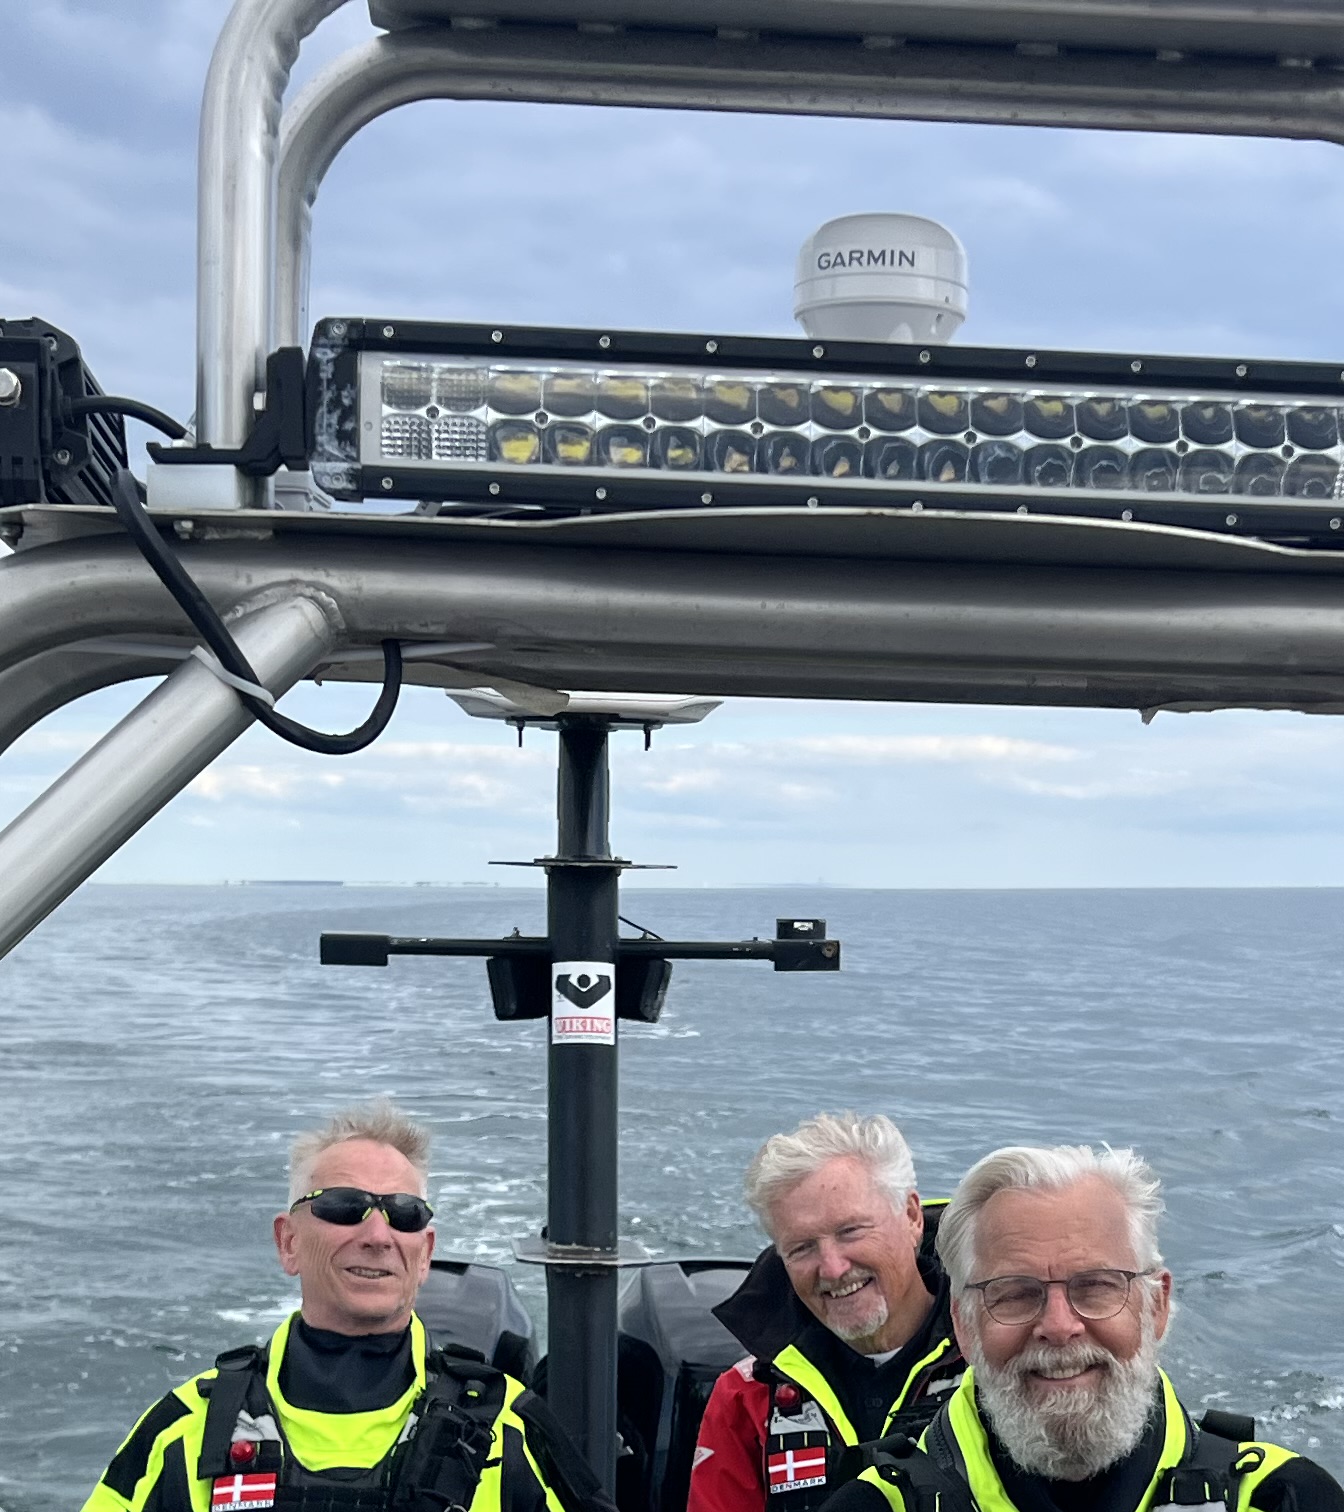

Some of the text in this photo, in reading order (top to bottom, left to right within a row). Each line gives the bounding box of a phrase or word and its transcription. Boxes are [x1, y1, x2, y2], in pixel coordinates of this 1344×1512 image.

[817, 249, 915, 271] GARMIN
[554, 1018, 612, 1033] VIKING
[771, 1478, 825, 1493] DENMARK
